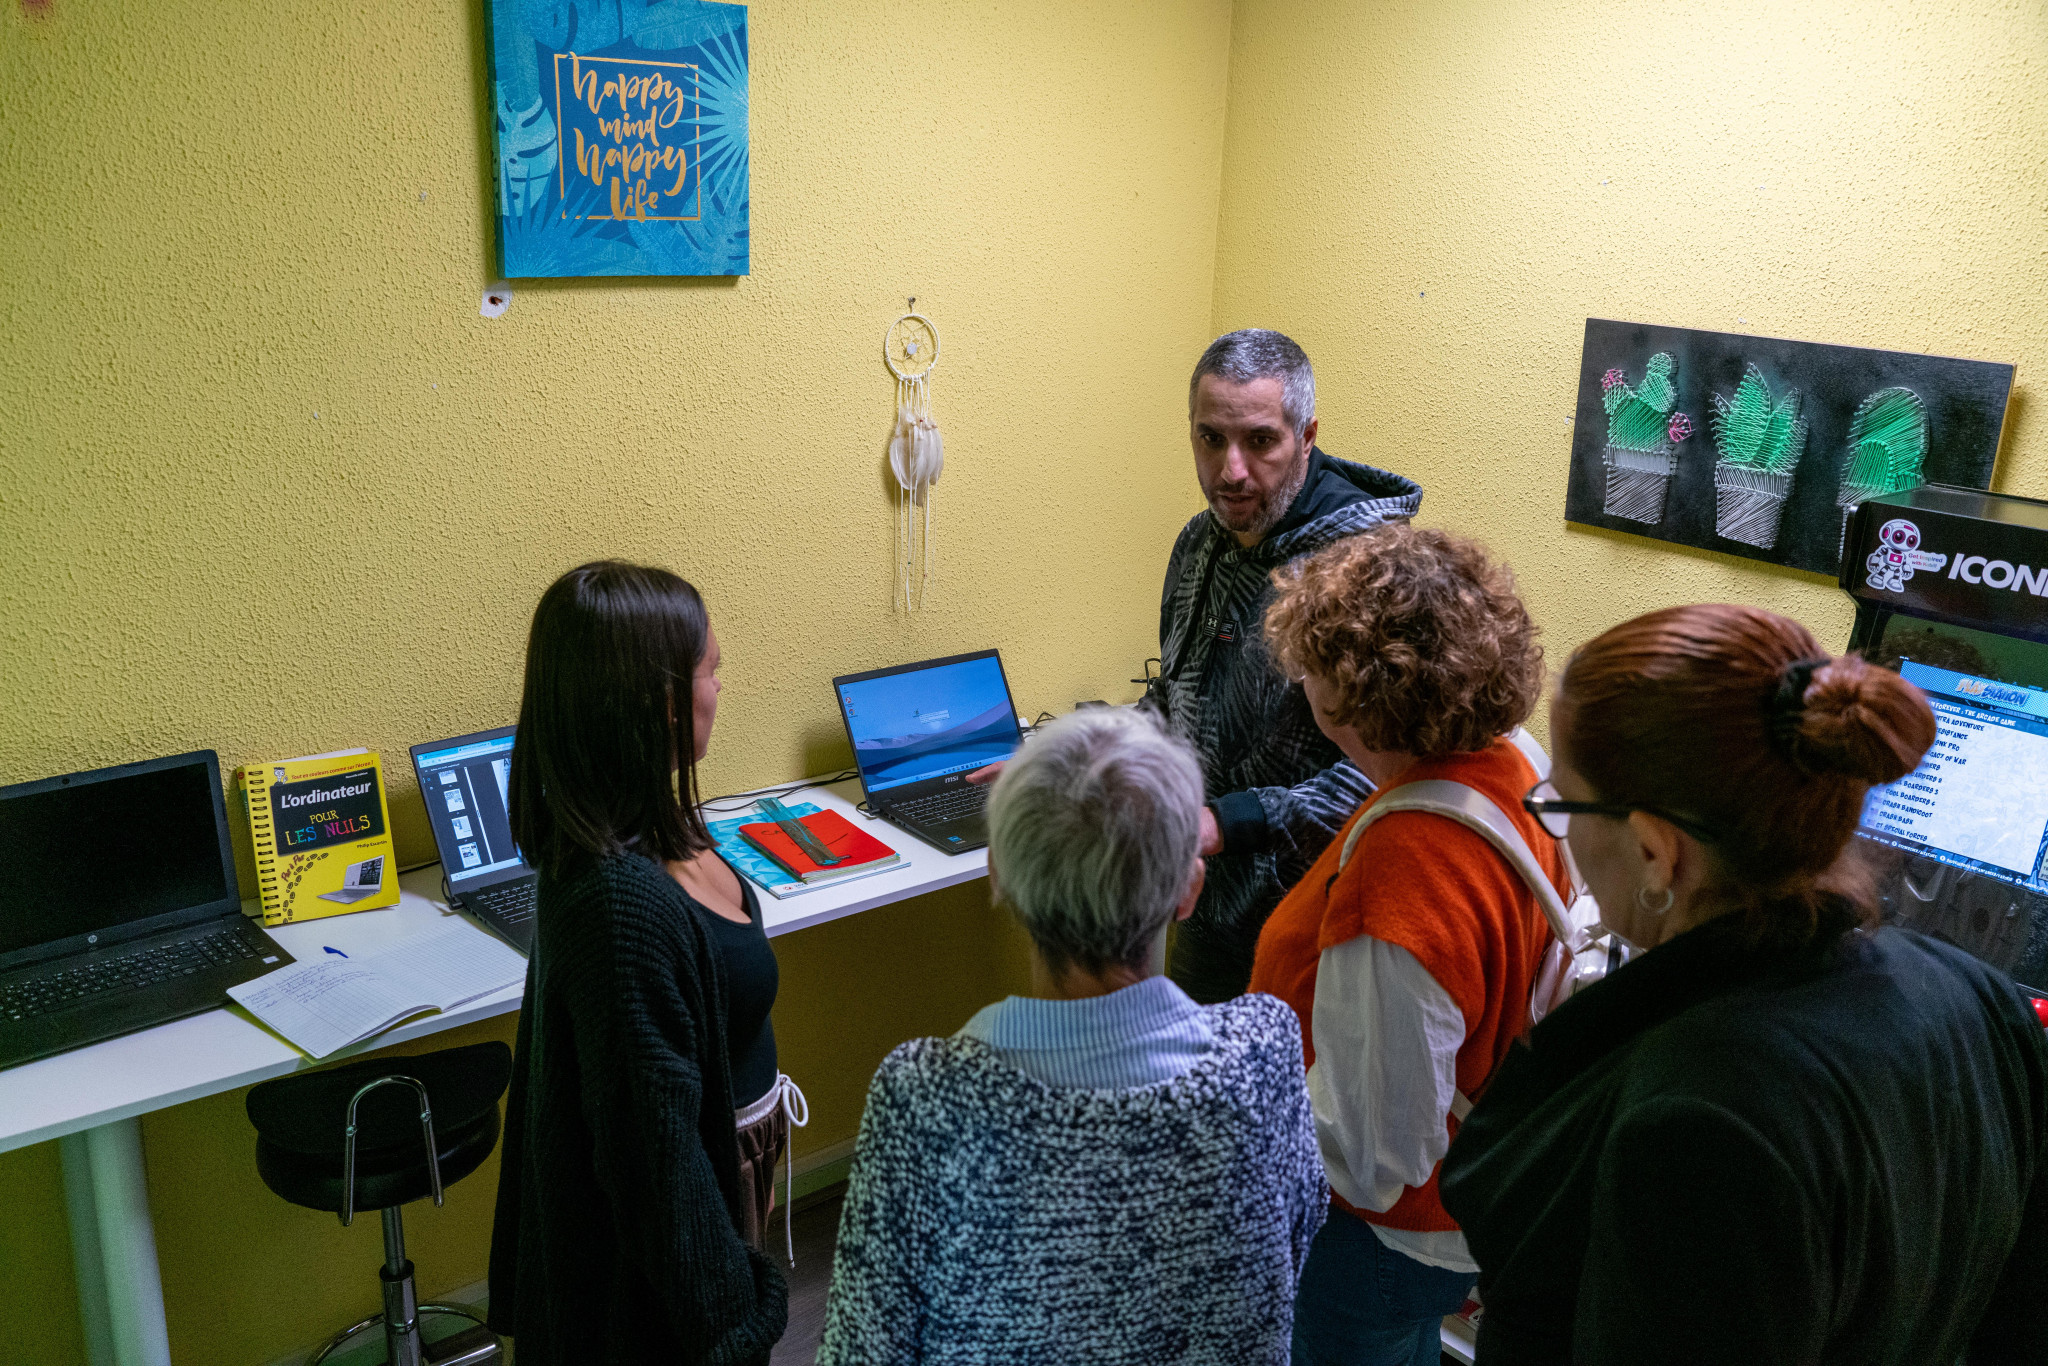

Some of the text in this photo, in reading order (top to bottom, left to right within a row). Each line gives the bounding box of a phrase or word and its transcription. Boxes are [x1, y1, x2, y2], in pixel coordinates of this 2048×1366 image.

[569, 51, 683, 128] happy
[598, 106, 660, 146] mind
[573, 127, 687, 197] happy
[610, 176, 658, 222] life
[1935, 702, 1961, 714] FOREVER
[1965, 709, 1976, 717] THE
[1976, 712, 2000, 723] ARCADE
[2000, 718, 2017, 727] GAME
[1951, 719, 1985, 732] ADVENTURE
[1948, 742, 1960, 752] PRO
[1953, 756, 1967, 765] WAR
[281, 782, 372, 809] L'ordinateur
[1903, 780, 1934, 794] BOARDERS
[1885, 788, 1899, 797] COOL
[1900, 792, 1931, 805] BOARDERS
[309, 809, 340, 824] POUR
[1882, 799, 1933, 818] CRASH BANDICOOT
[1879, 811, 1914, 825] CRASH BASH
[285, 814, 371, 846] LES NULS
[1884, 824, 1906, 836] SPECIAL
[1905, 831, 1928, 842] FORCES
